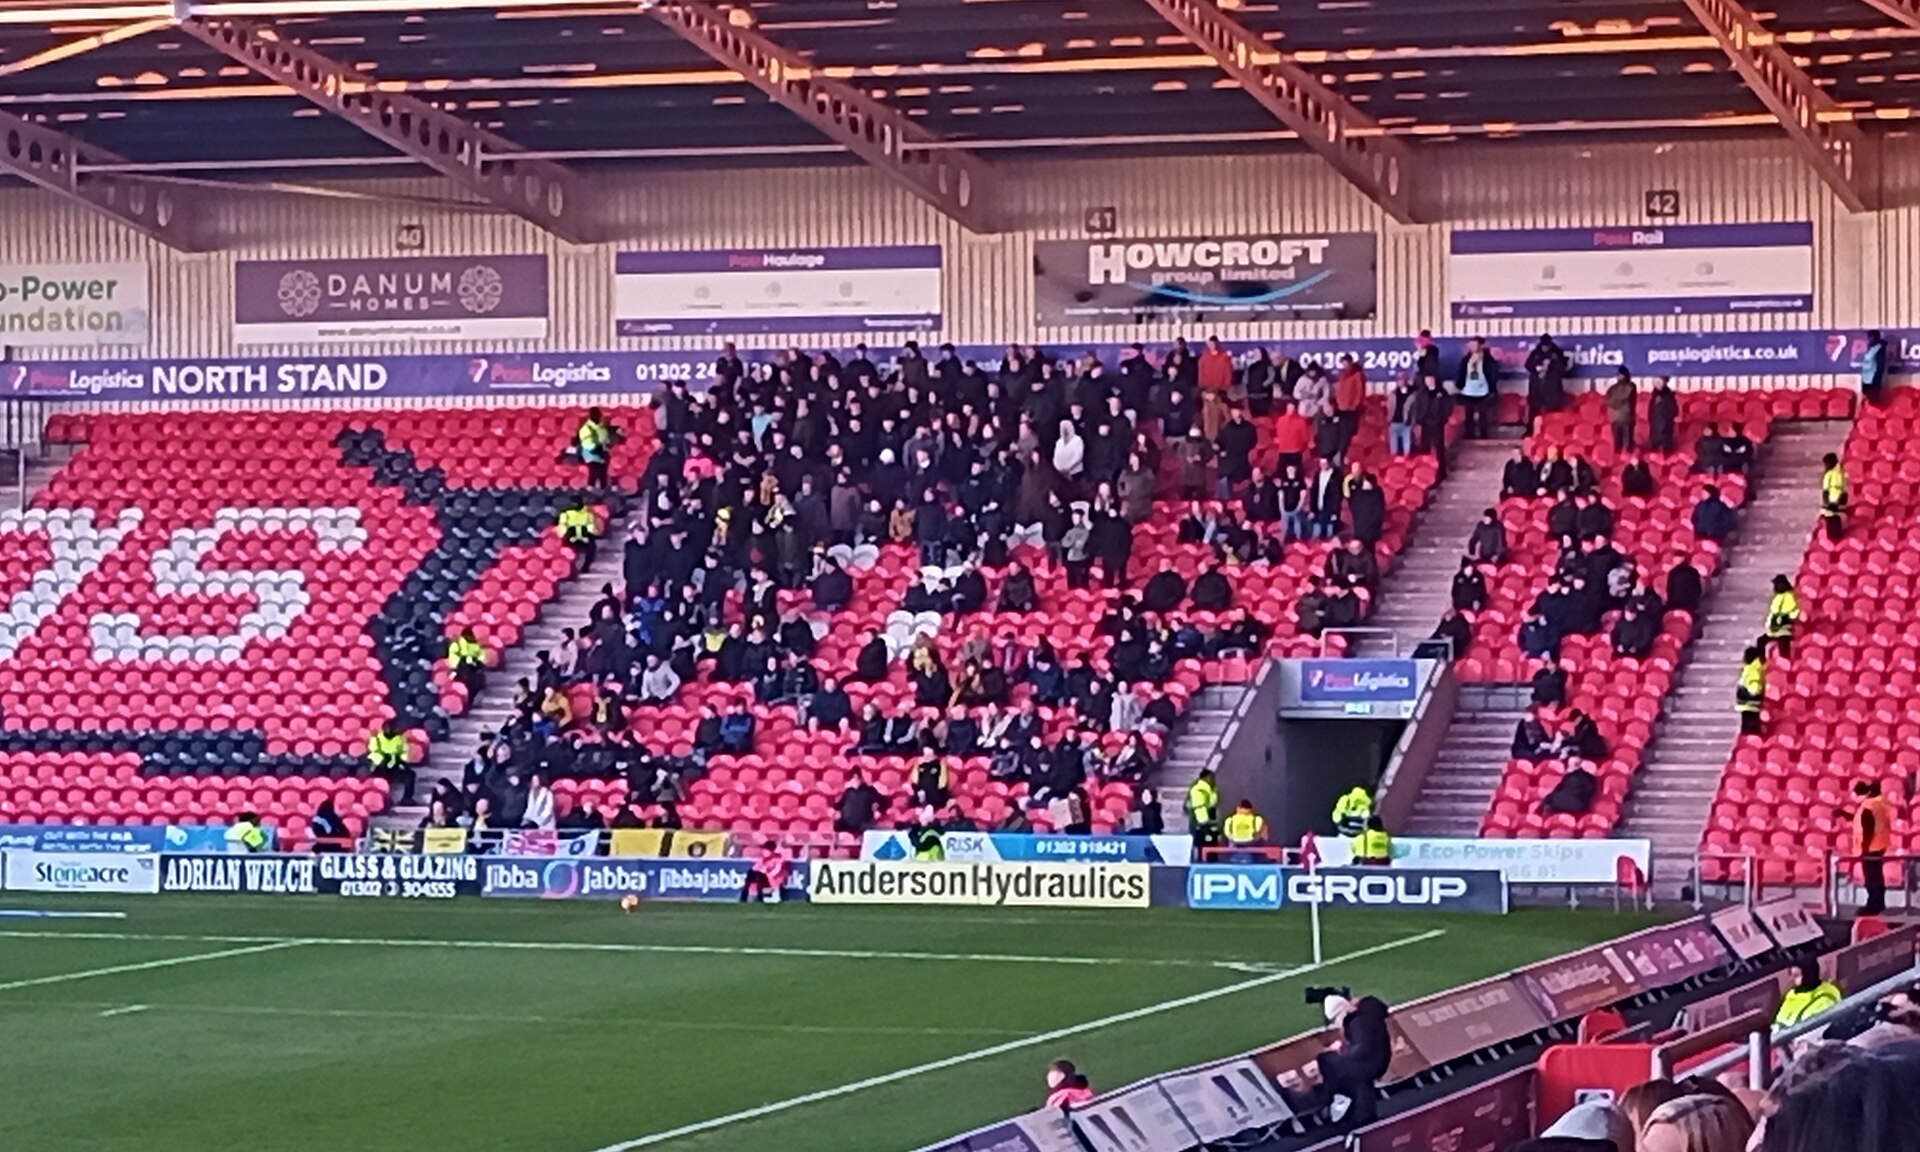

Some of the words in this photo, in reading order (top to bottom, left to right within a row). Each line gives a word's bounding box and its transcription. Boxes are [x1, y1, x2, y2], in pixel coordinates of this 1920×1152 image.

[1649, 194, 1676, 214] 42
[1089, 212, 1113, 229] 41
[398, 229, 422, 247] 40
[1088, 239, 1330, 284] HOWCROFT
[327, 271, 452, 297] DANUM
[1151, 270, 1214, 286] group
[1220, 266, 1295, 281] limited
[349, 297, 430, 312] HOMES
[1648, 345, 1798, 364] passlogistics.co.uk
[152, 365, 268, 394] NORTH
[277, 364, 389, 392] STAND
[636, 362, 691, 380] 01302
[946, 837, 984, 853] RISK
[1418, 843, 1526, 860] Eco-Power
[35, 862, 129, 882] Stoneacre
[164, 858, 241, 891] ADRIAN
[244, 859, 314, 892] WELCH
[320, 855, 379, 879] GLASS
[381, 856, 396, 879] &
[400, 856, 477, 880] GLAZING
[1192, 873, 1278, 901] IPM
[1288, 875, 1467, 904] GROUP
